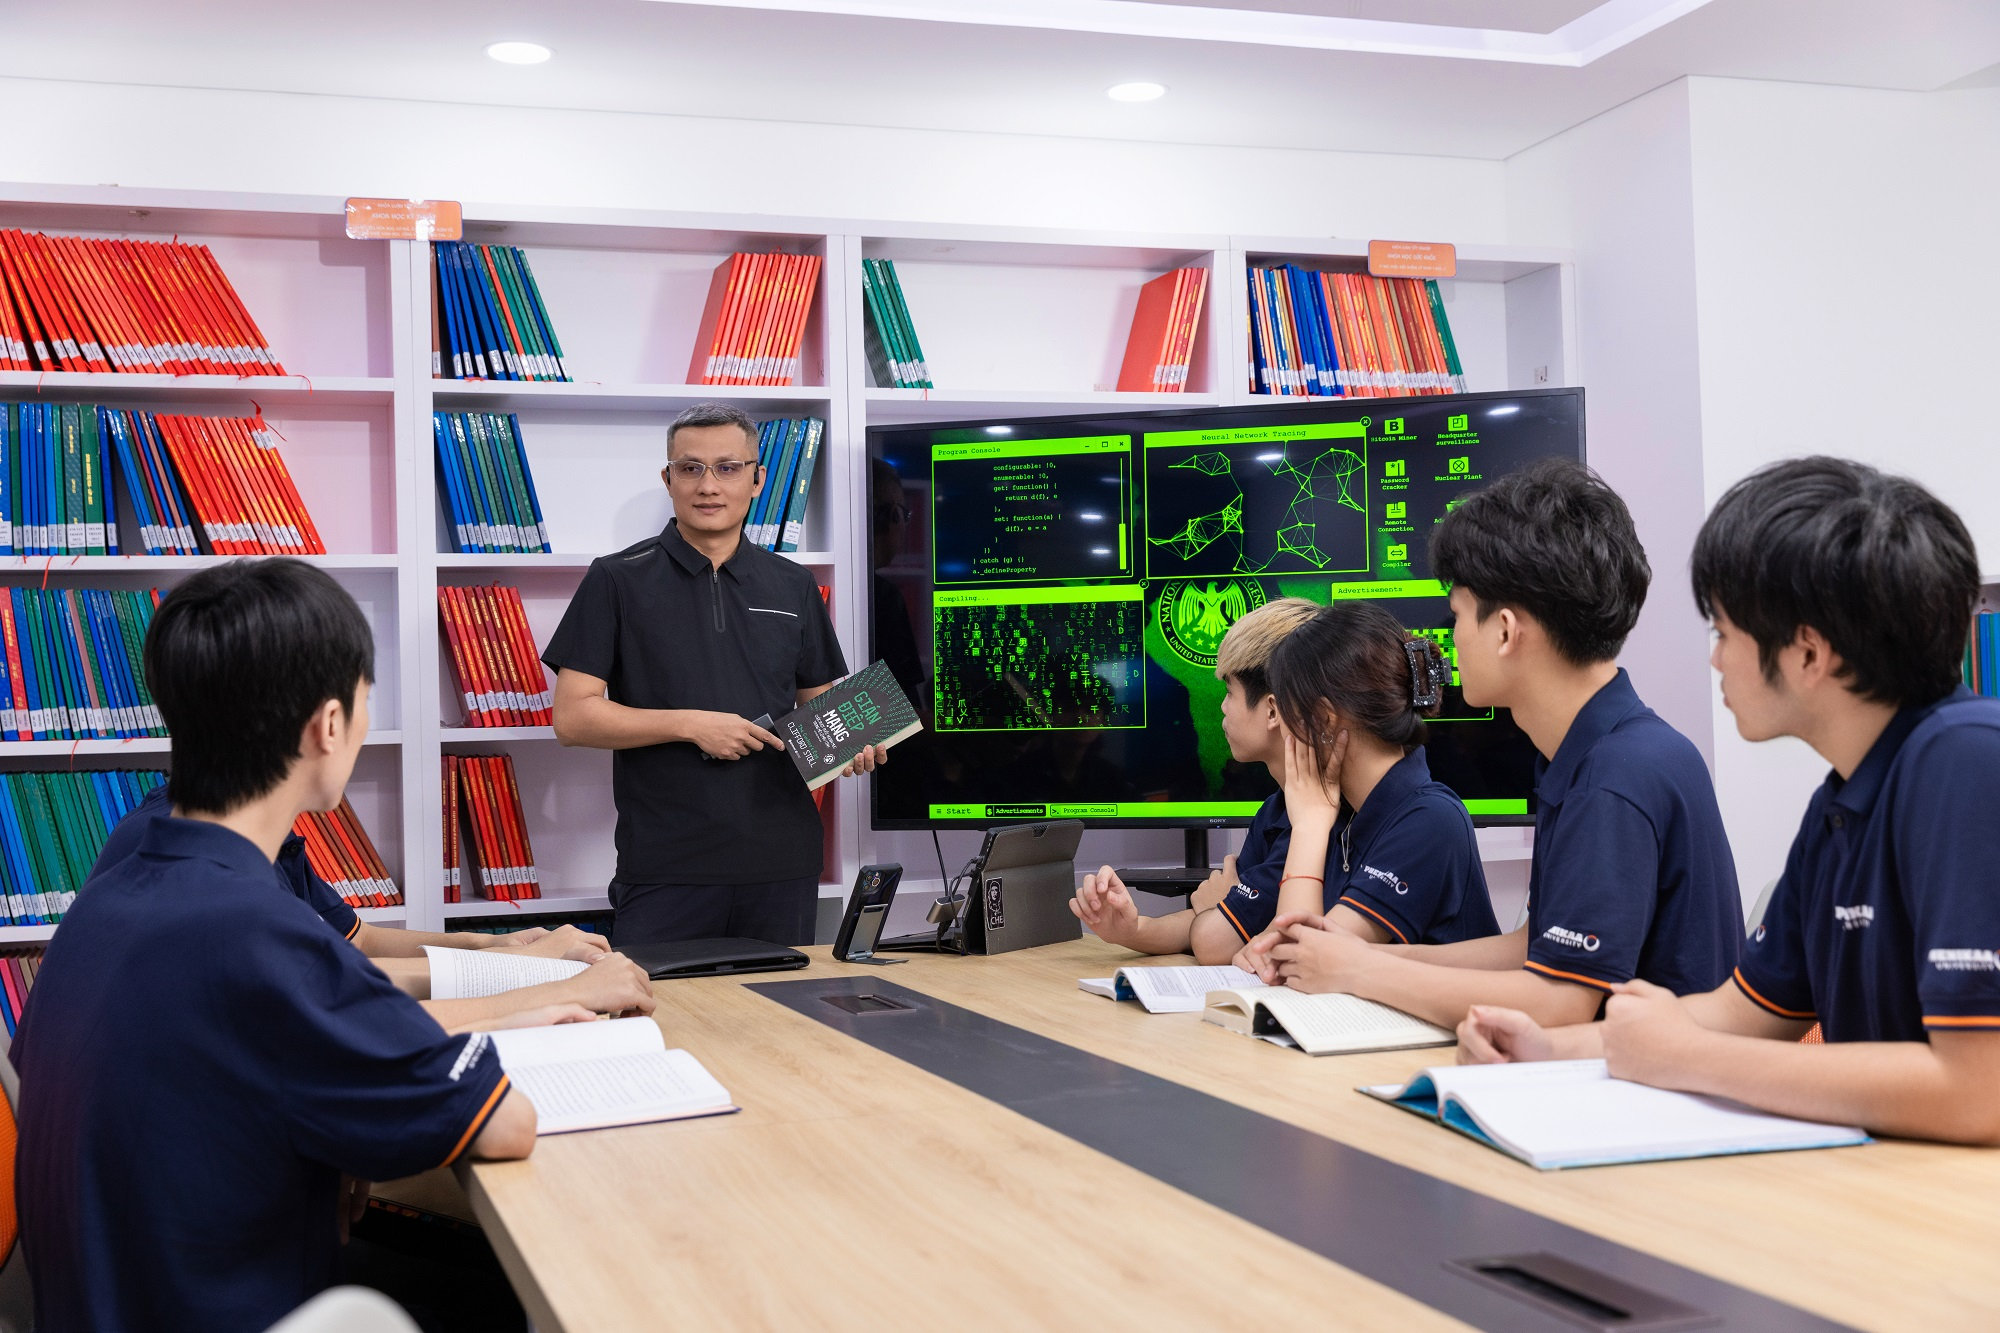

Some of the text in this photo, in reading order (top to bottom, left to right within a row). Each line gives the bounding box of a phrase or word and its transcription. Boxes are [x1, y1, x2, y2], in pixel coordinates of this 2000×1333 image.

[1234, 431, 1268, 439] Network
[1272, 430, 1307, 438] Tracing
[993, 463, 1042, 471] configurable:
[1338, 586, 1403, 594] Advertisements
[1170, 636, 1218, 665] UNITED STATES
[838, 701, 865, 730] ĐIỆP
[854, 691, 882, 725] GIÁN
[822, 709, 850, 742] MẠNG
[788, 722, 808, 750] CLIFFORD
[803, 750, 816, 768] STOLL
[991, 916, 1004, 925] CHE
